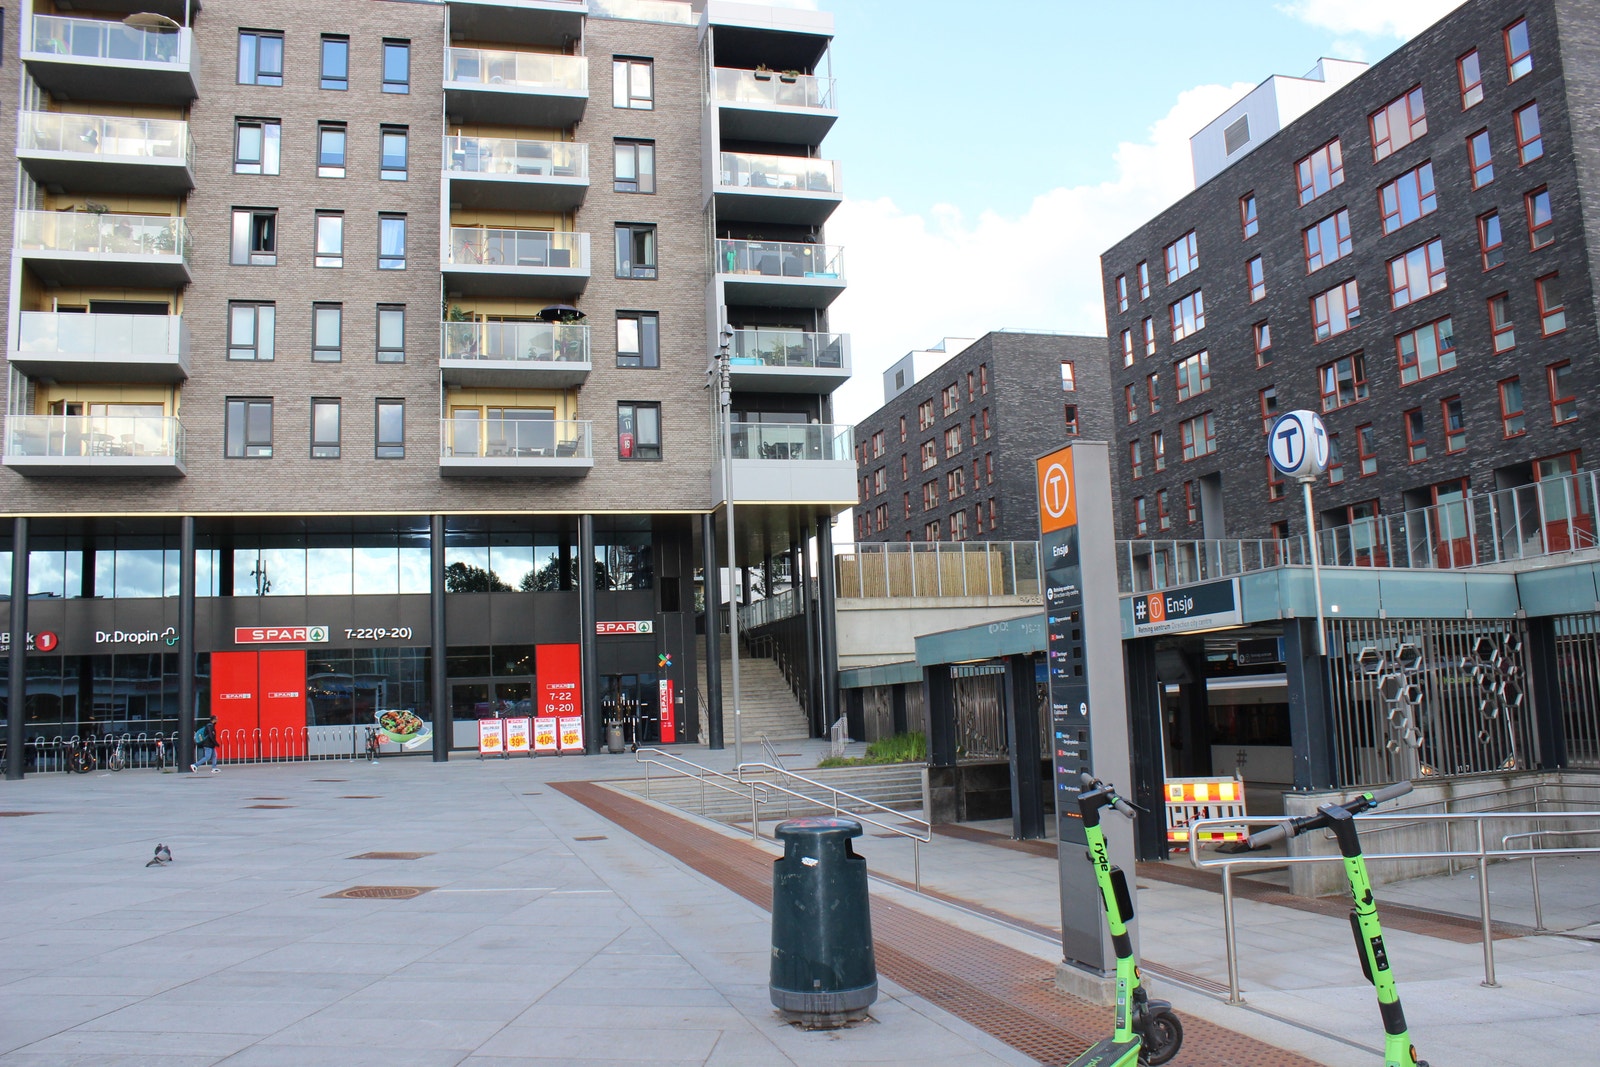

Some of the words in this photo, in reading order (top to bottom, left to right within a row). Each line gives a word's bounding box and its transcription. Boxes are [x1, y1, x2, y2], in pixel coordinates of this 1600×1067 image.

[1278, 428, 1297, 463] T
[1314, 428, 1324, 461] T
[1049, 476, 1062, 510] T
[1052, 544, 1069, 557] Ensjø
[1166, 595, 1194, 615] Ensjø
[252, 629, 306, 641] SPAR
[344, 626, 413, 641] 7-22(9-20)
[596, 623, 636, 632] SPAR
[41, 634, 51, 648] 1
[95, 630, 158, 646] Dr.Dropin
[549, 692, 572, 701] 7-22
[545, 703, 575, 713] (9-20)
[1094, 841, 1109, 872] ryde
